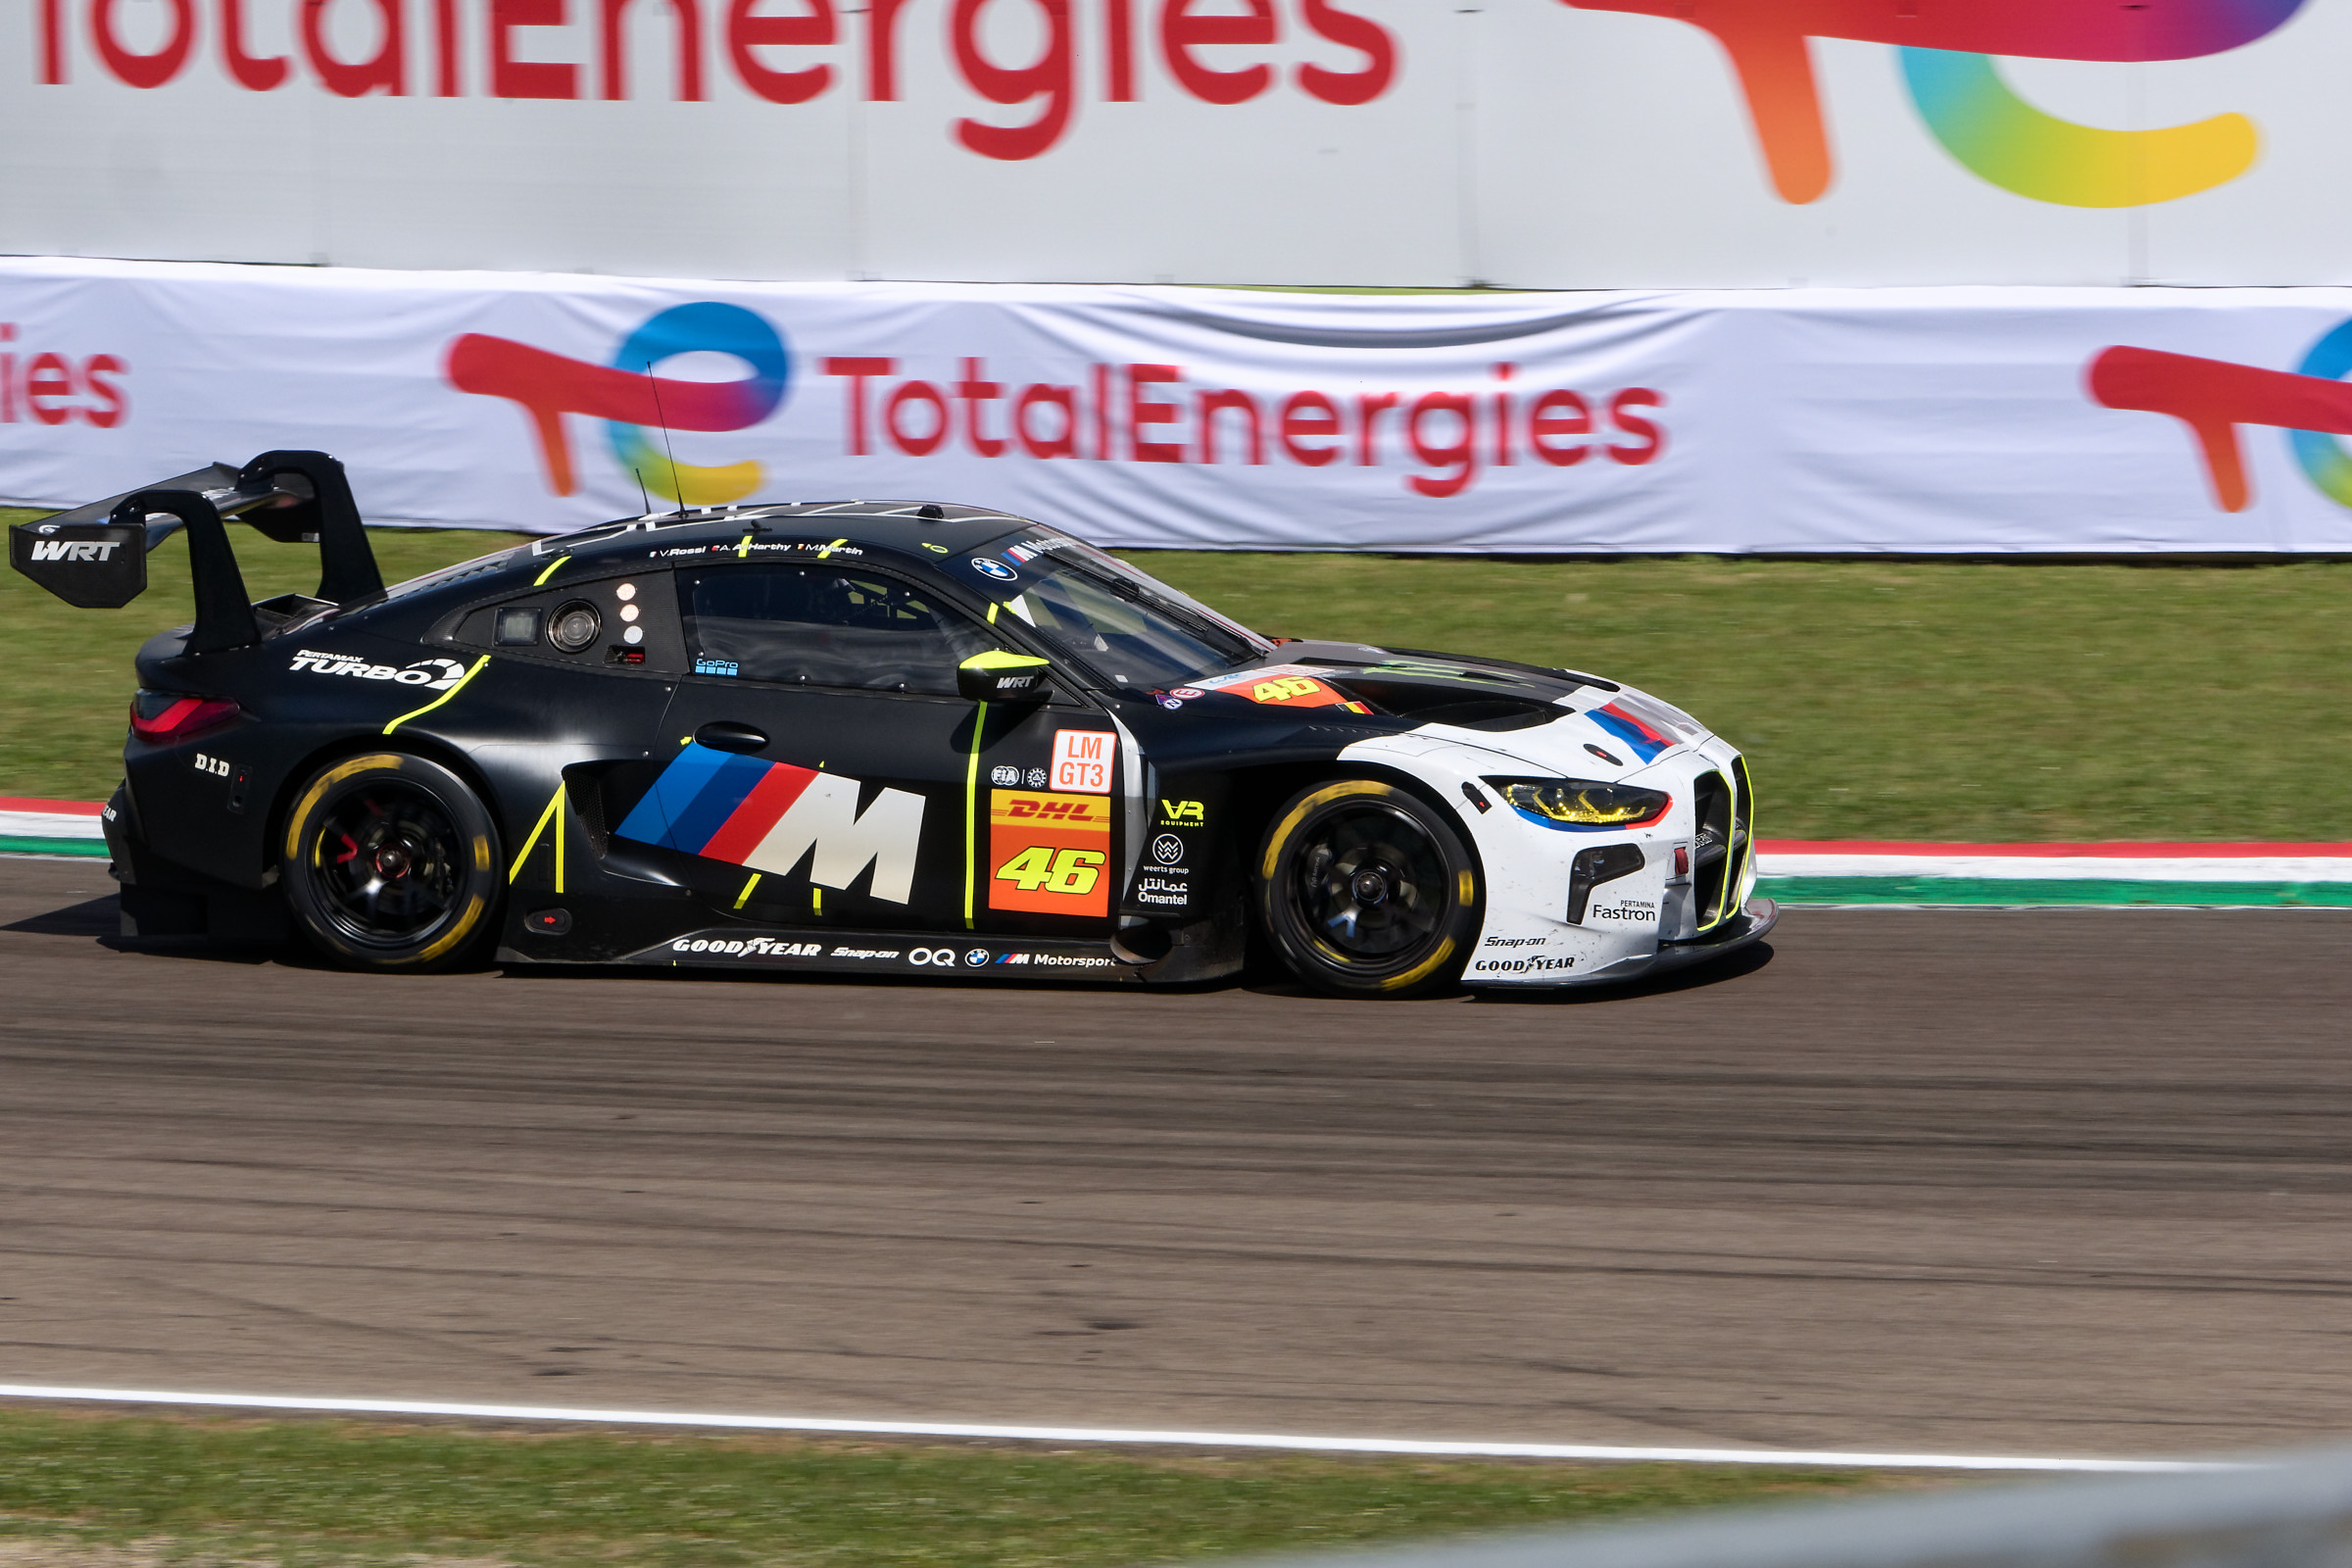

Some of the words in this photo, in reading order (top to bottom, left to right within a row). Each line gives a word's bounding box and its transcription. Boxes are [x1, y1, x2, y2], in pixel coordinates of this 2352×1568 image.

[820, 356, 1664, 497] TotalEnergies
[31, 541, 120, 562] WRT
[296, 650, 364, 662] PERTAMAX
[696, 659, 739, 668] GoPro
[289, 656, 432, 685] TURBO
[996, 675, 1035, 689] WRT
[1252, 675, 1321, 702] 46
[1067, 735, 1102, 760] LM
[194, 753, 230, 777] D.I.D
[1058, 761, 1103, 787] GT3
[1007, 799, 1095, 821] DHL
[1161, 799, 1204, 820] VR
[995, 846, 1106, 895] 46
[1143, 864, 1168, 873] weerts
[1138, 877, 1188, 893] عمانتل
[1138, 891, 1188, 905] Omantel
[1620, 900, 1655, 908] PERTAMINA
[1592, 904, 1656, 921] Fastron
[1484, 936, 1546, 949] Snap-on
[830, 947, 900, 958] Snap-on
[908, 947, 956, 967] OQ
[1034, 954, 1116, 968] Motorsport
